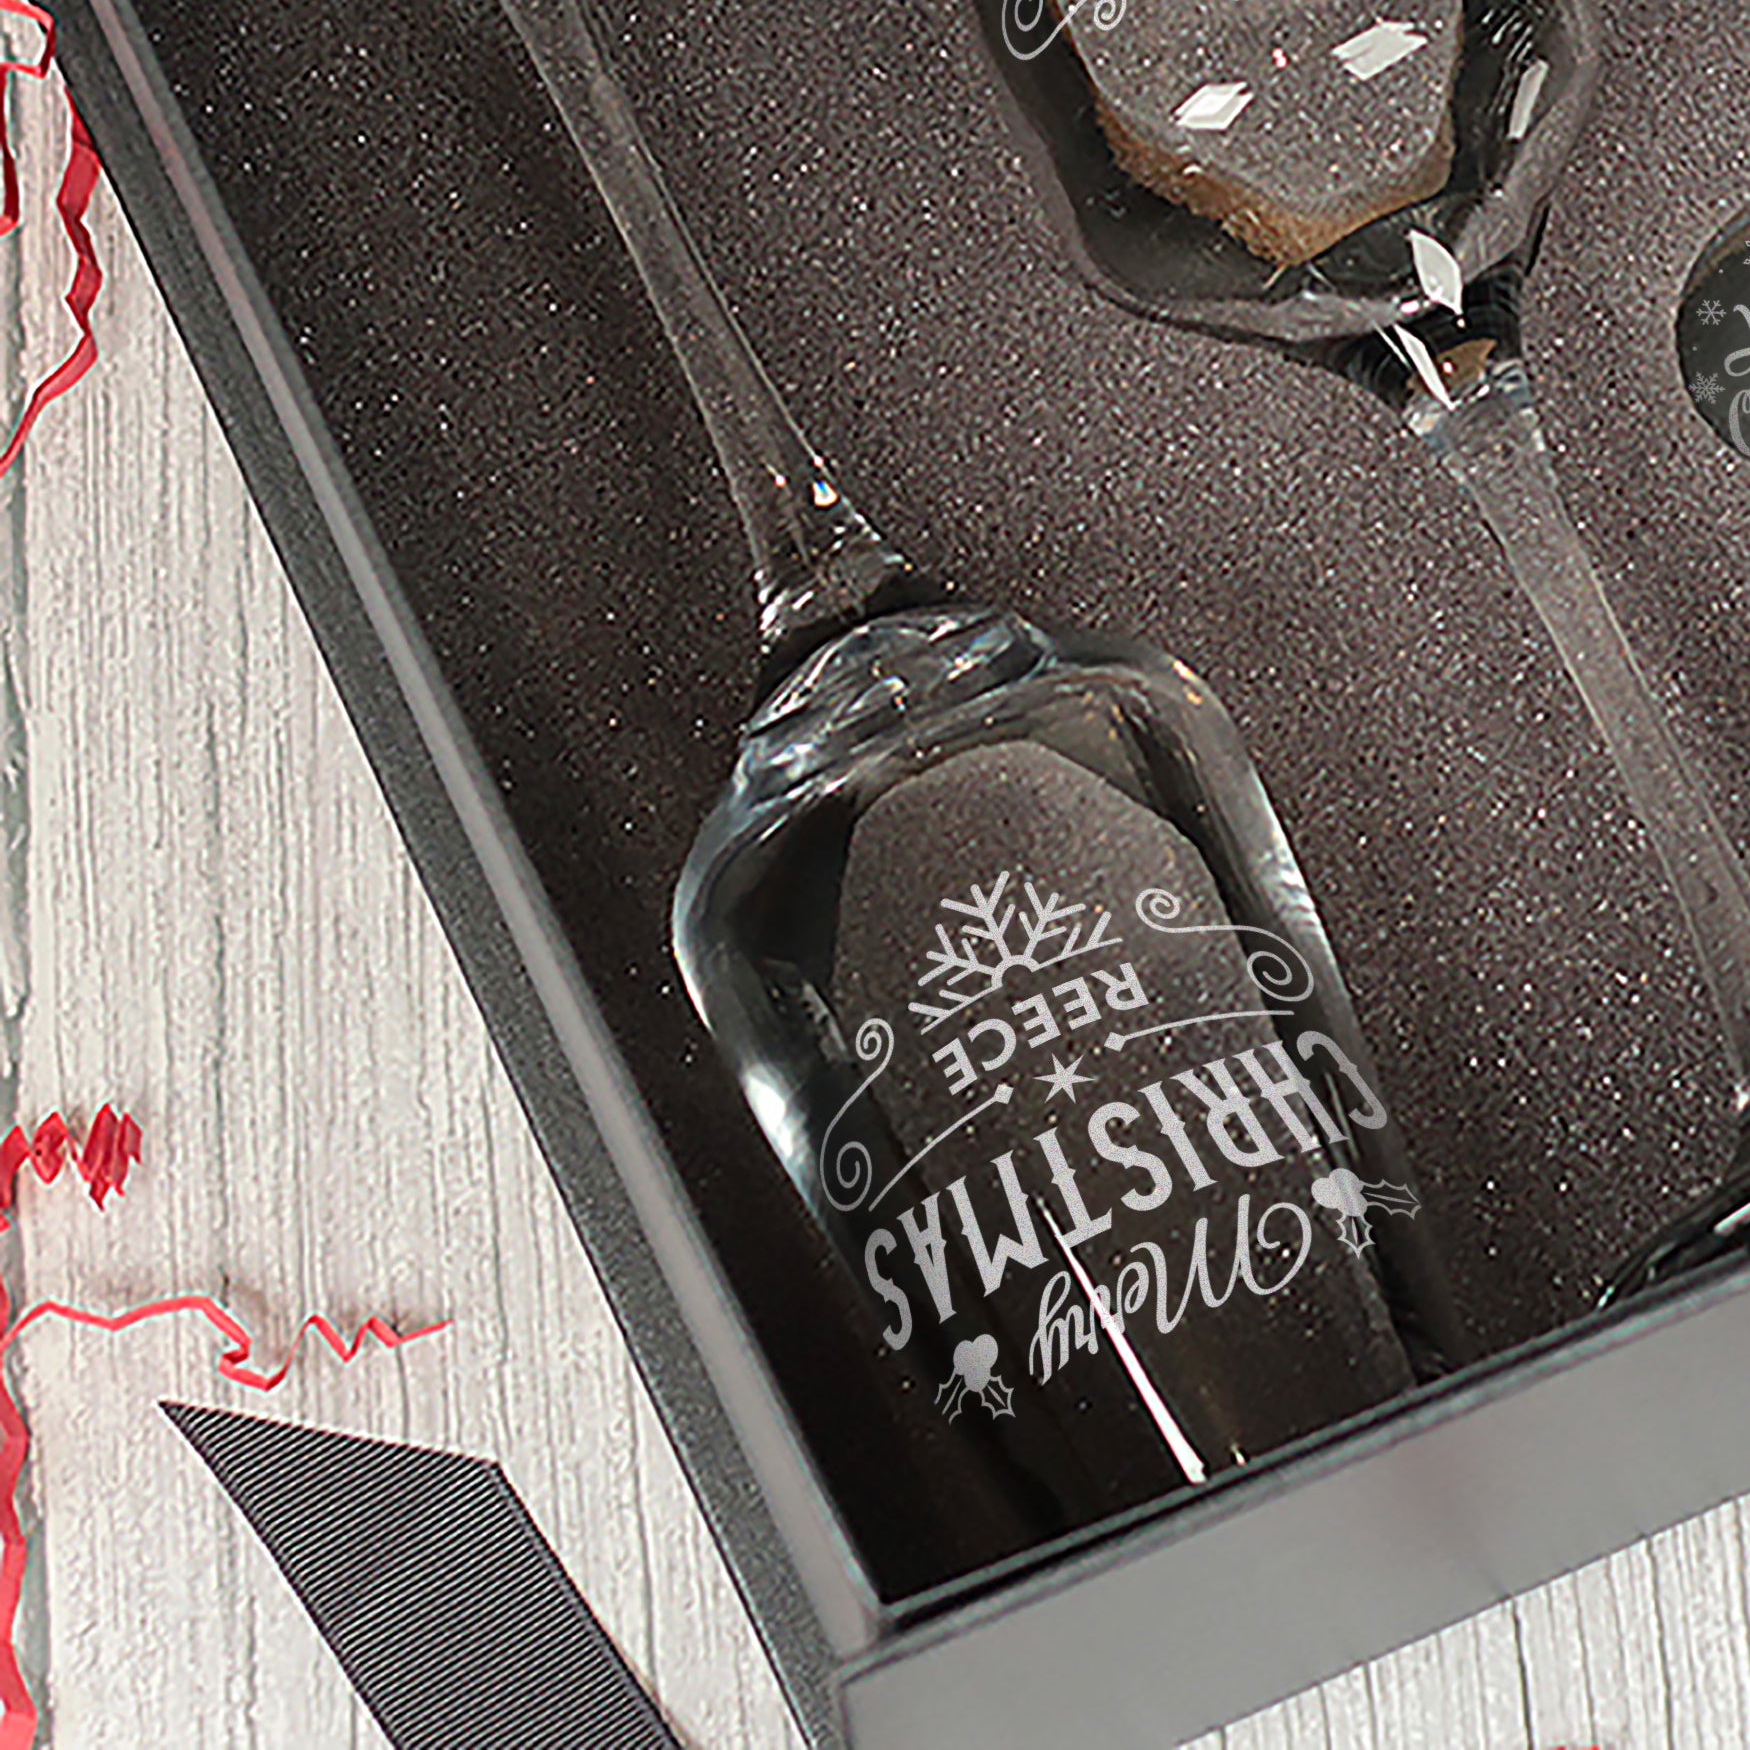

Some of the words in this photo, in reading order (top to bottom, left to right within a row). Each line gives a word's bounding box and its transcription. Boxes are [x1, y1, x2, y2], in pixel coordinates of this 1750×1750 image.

[932, 962, 1149, 1095] REECE
[864, 1030, 1388, 1350] CHRISTMAS
[1028, 1193, 1313, 1386] Merry
